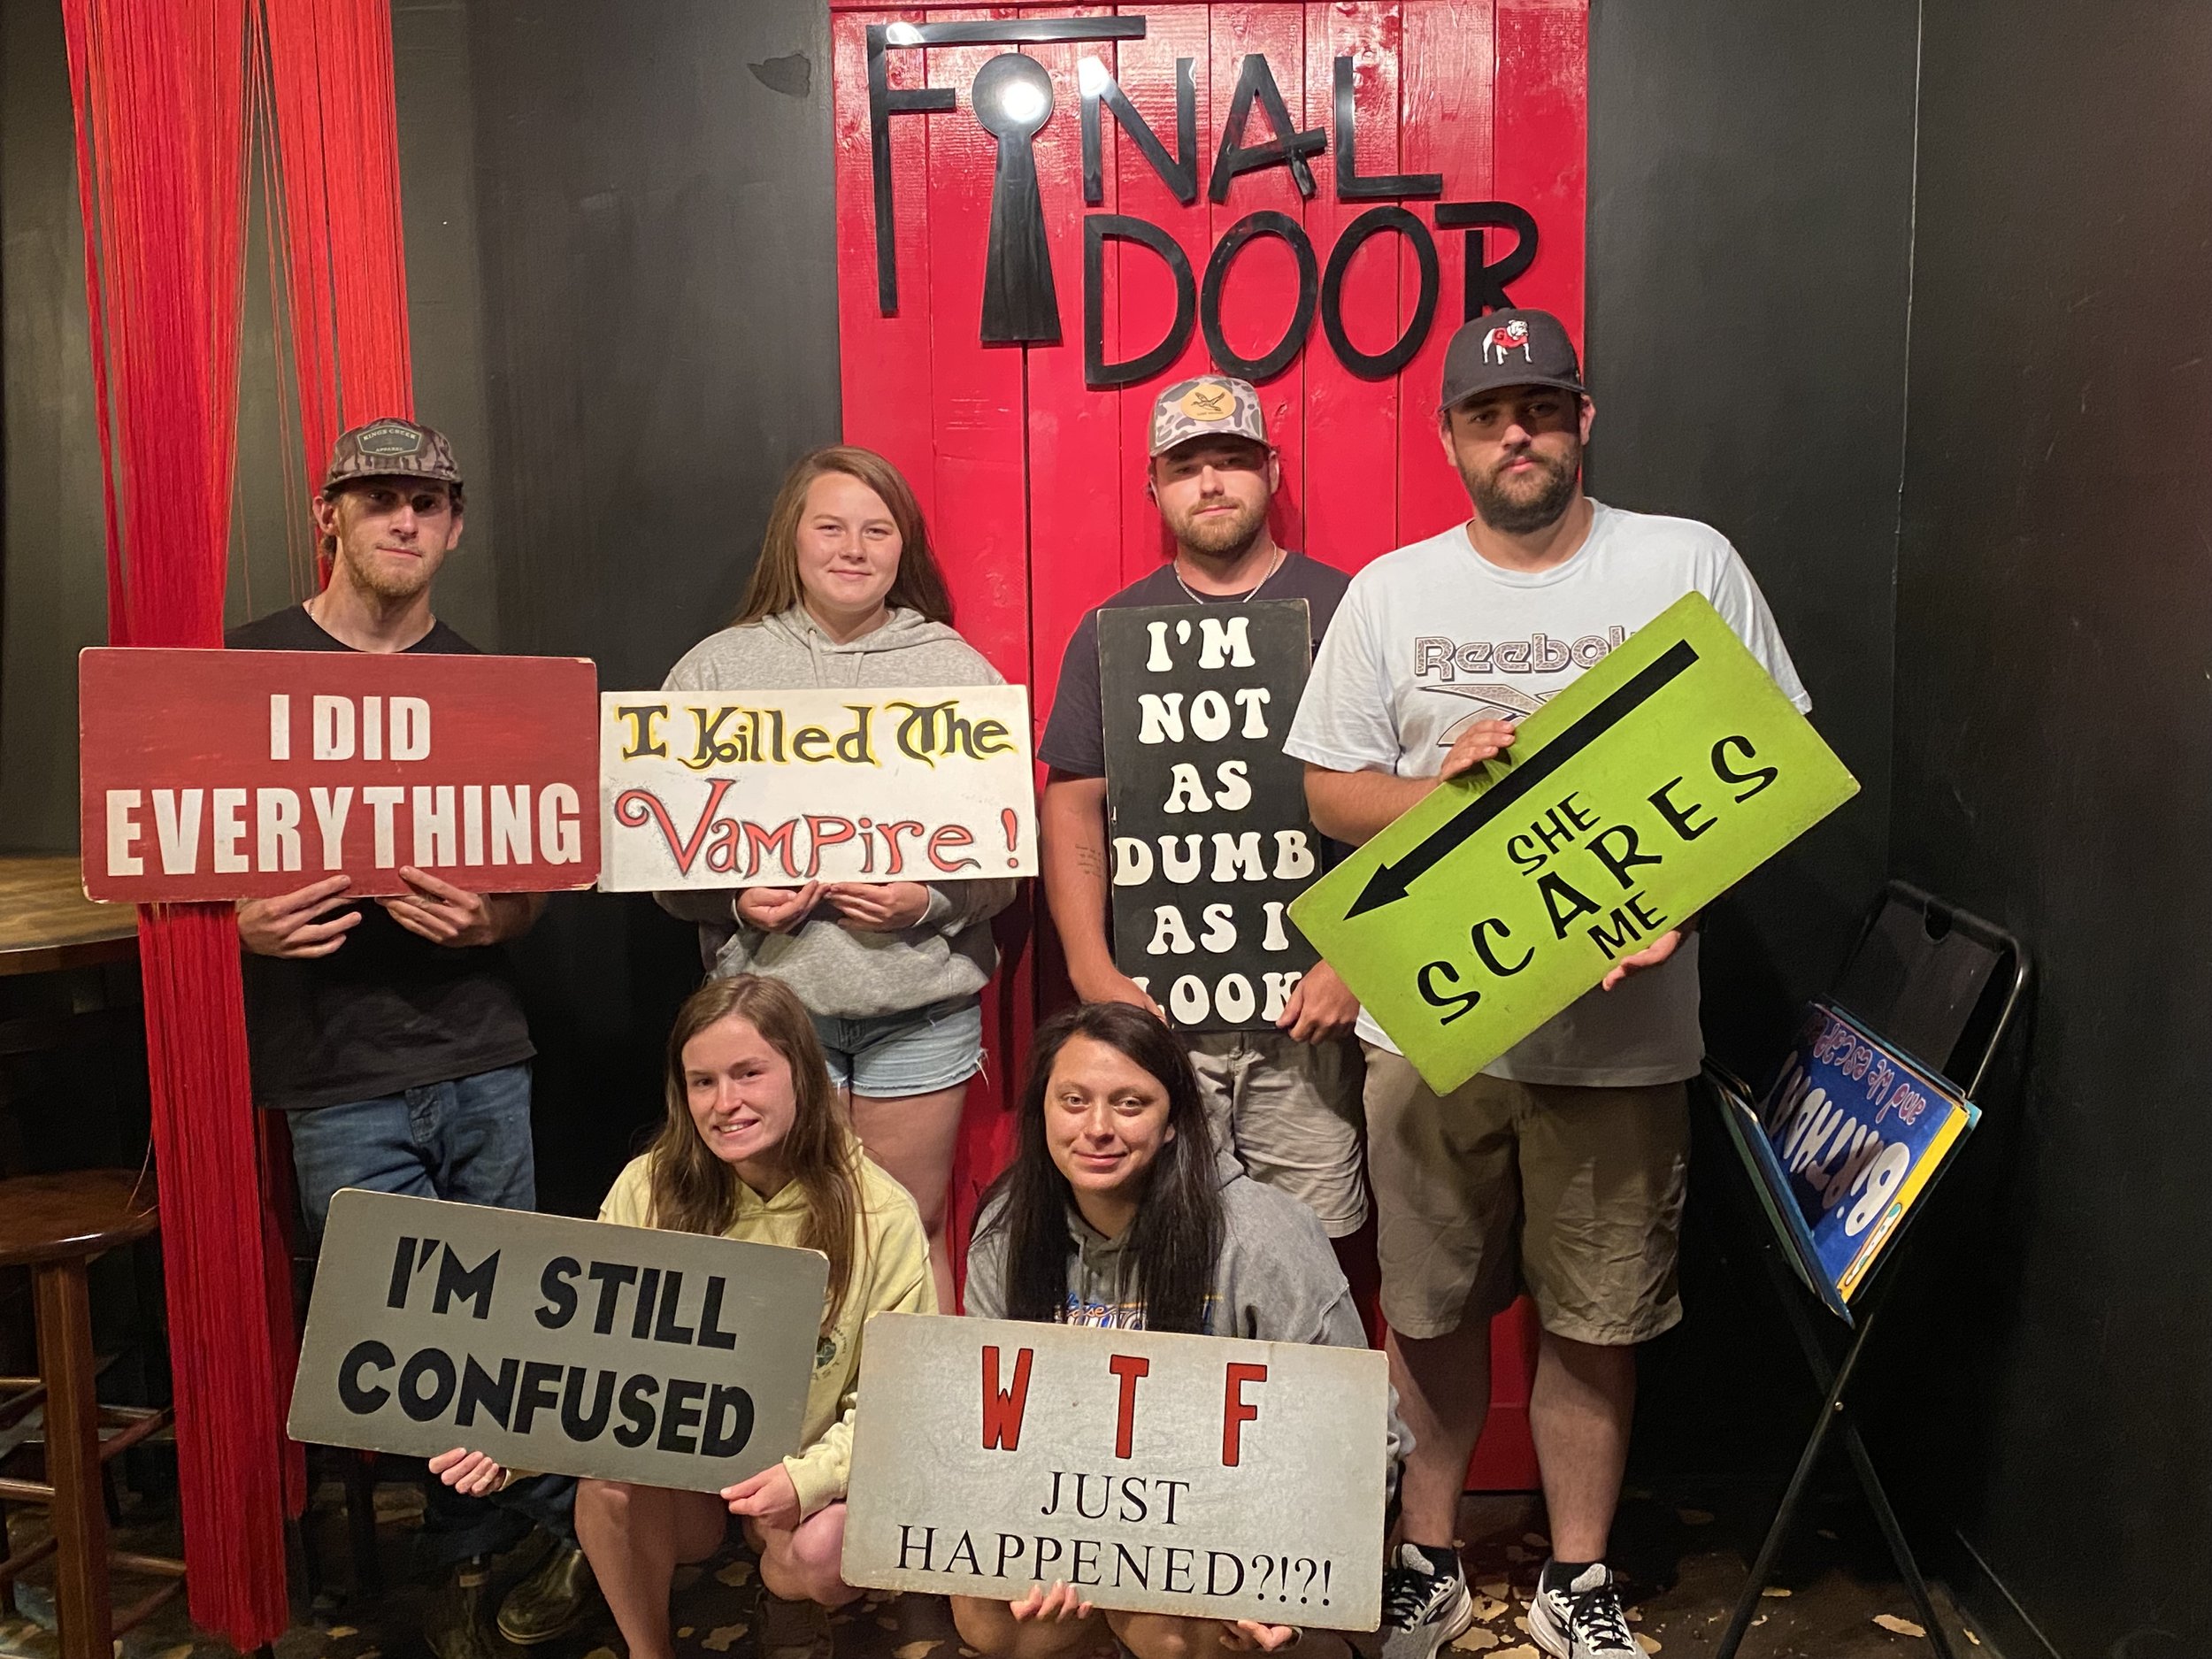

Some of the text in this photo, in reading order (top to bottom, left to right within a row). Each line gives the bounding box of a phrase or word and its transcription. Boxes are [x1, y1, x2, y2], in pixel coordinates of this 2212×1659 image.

[1083, 200, 1539, 387] DOOR
[1146, 617, 1256, 672] I'M
[269, 694, 431, 761] I DID
[618, 700, 1016, 771] I Killed The
[1138, 687, 1271, 744] NOT
[1163, 760, 1253, 814] AS
[105, 782, 582, 876] EVERYTHING
[1112, 830, 1316, 887] DUMB
[1507, 791, 1601, 876] SHE
[1417, 735, 1778, 1025] SCARES
[1146, 902, 1290, 956] AS I
[1586, 890, 1669, 961] ME
[386, 1235, 737, 1350] I'M STILL
[337, 1340, 756, 1458] CONFUSED
[1041, 1471, 1190, 1525] JUST
[895, 1524, 1333, 1607] HAPPENED?!?!
